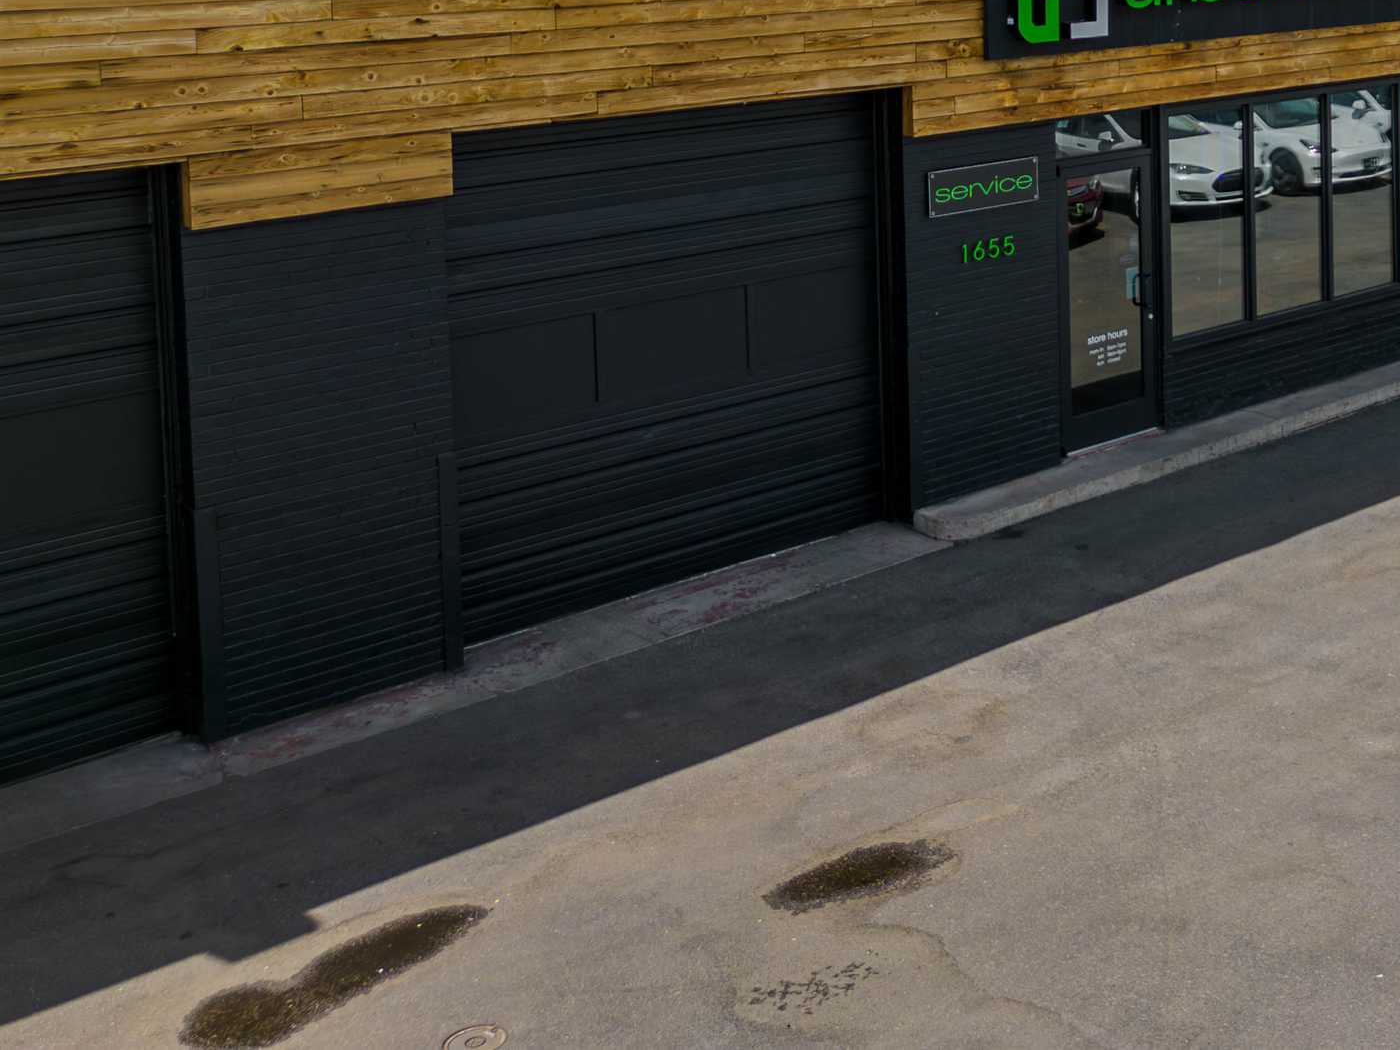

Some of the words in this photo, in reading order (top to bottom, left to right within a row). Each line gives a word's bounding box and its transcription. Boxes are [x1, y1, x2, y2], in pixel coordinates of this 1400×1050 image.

[935, 174, 1033, 203] service
[962, 235, 1015, 263] 1655
[1087, 334, 1106, 345] store
[1107, 328, 1128, 341] hours
